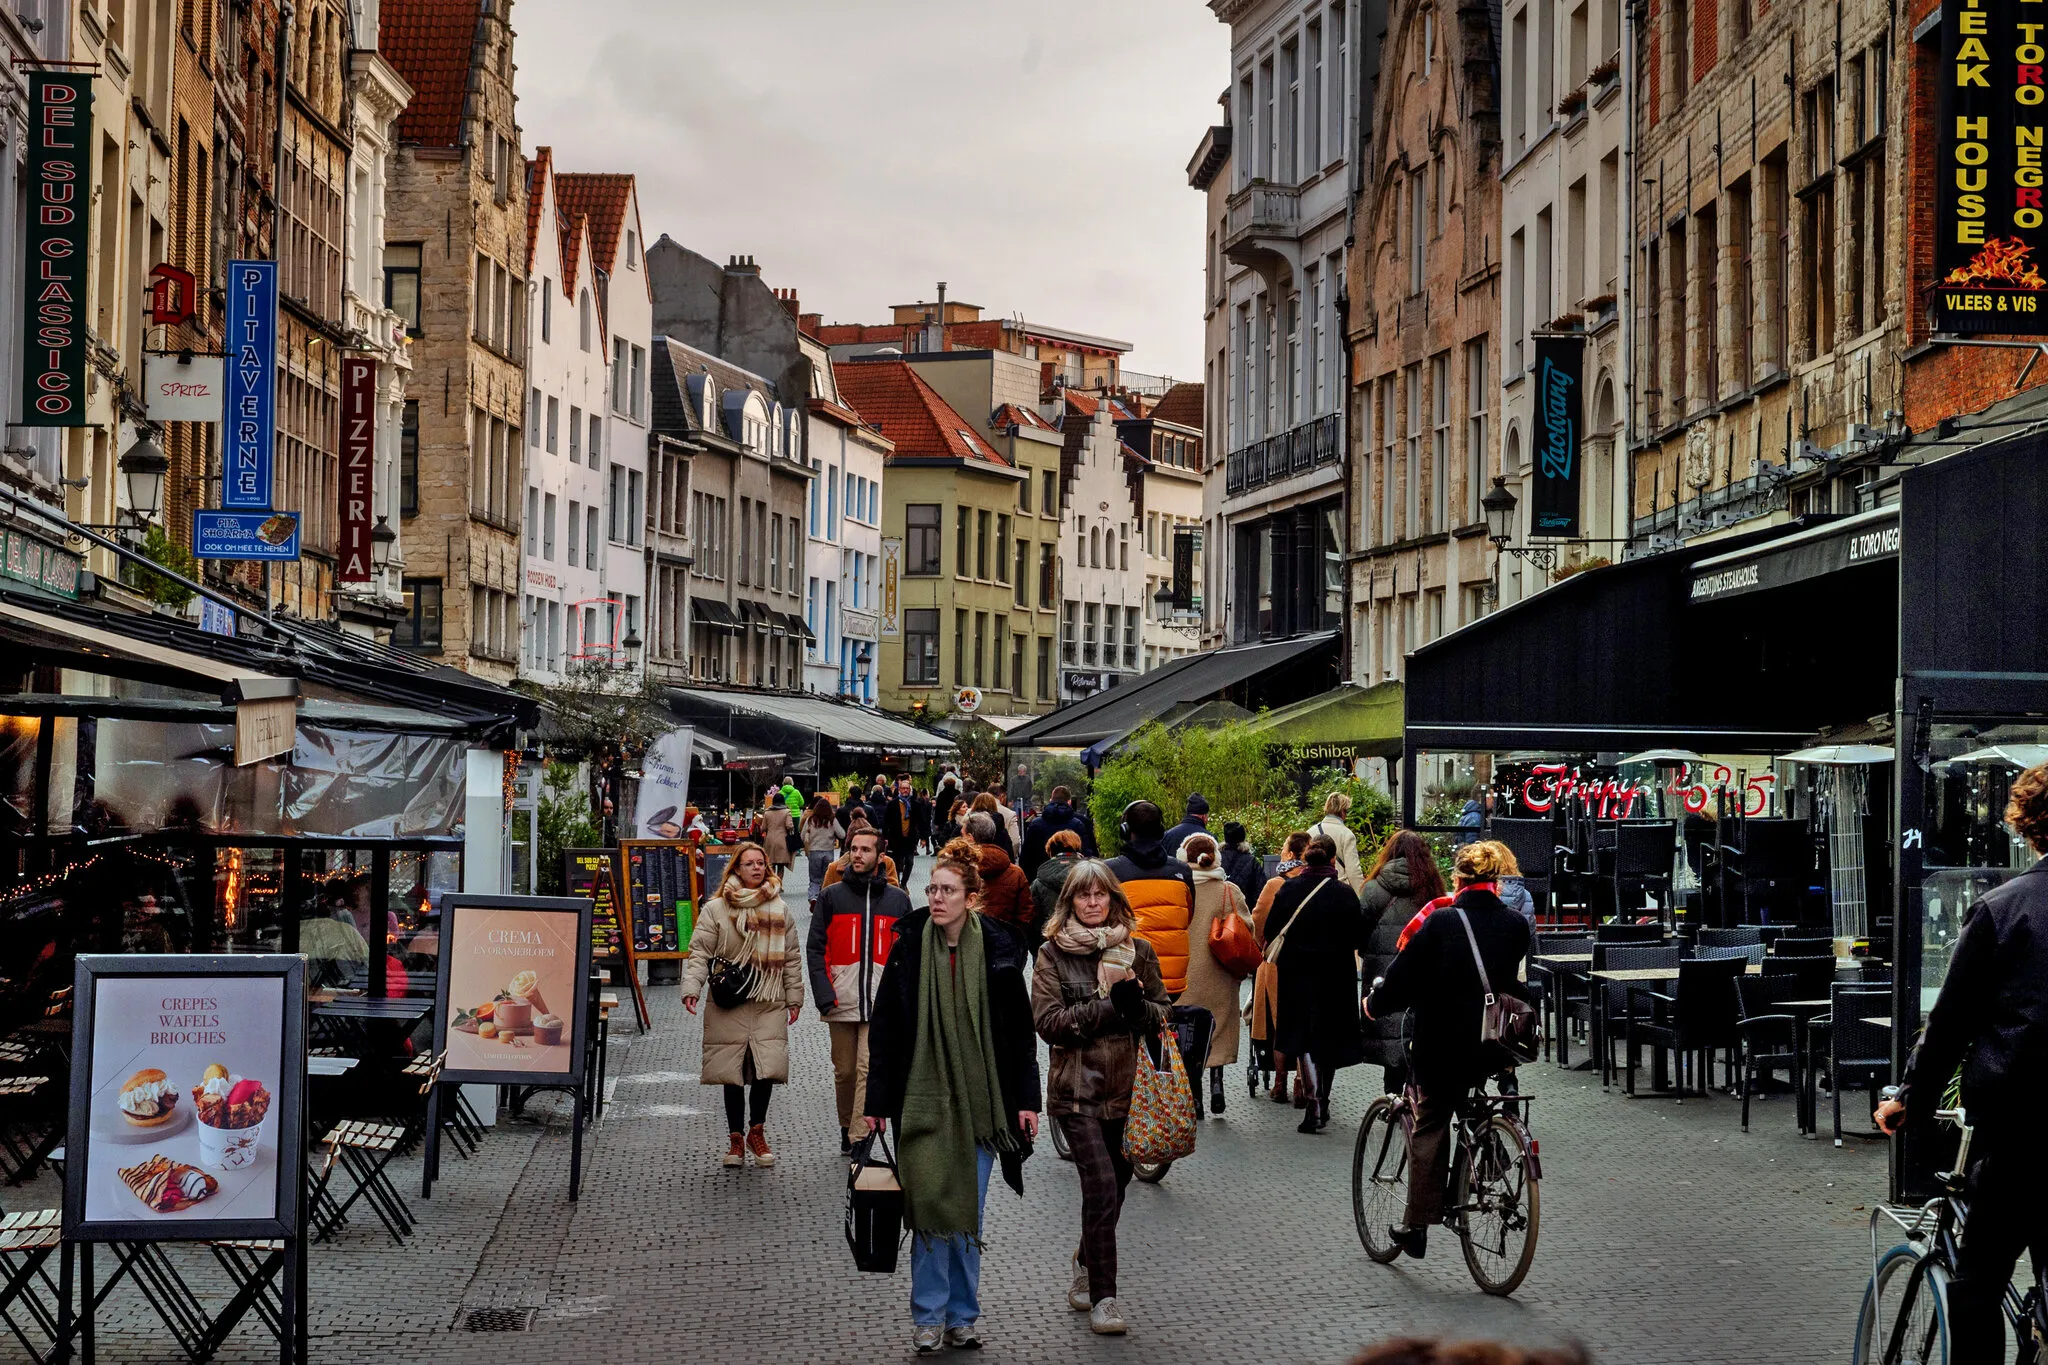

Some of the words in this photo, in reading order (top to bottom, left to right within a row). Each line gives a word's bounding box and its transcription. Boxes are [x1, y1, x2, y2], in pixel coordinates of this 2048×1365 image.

[1956, 0, 1991, 87] EAK
[2015, 23, 2045, 105] TORO
[42, 84, 77, 148] DEL
[1955, 116, 1989, 244] HOUSE
[2013, 126, 2044, 229] NEGRO
[40, 160, 76, 225] SUD
[1945, 294, 1993, 311] VLEES
[1997, 295, 2008, 312] &
[2012, 295, 2037, 312] VIS
[36, 237, 74, 415] CLASSICO
[160, 382, 210, 397] SPRITZ
[237, 269, 262, 494] PITAVERNE
[1541, 356, 1574, 481] Zaowang
[345, 366, 369, 575] PIZZERIA
[202, 528, 255, 539] SHOARMA
[217, 517, 240, 528] PITA
[7, 534, 23, 574] DEL
[25, 541, 41, 580] SUD
[204, 543, 223, 551] OOK
[238, 544, 253, 552] MEE
[1850, 537, 1858, 559] EL
[1859, 531, 1881, 558] TORO
[1178, 543, 1189, 600] VERONA
[1722, 564, 1759, 592] STEAKHOUSE
[1292, 744, 1357, 759] sushibar
[474, 945, 486, 954] EN
[487, 946, 555, 957] ORANJEBLOEM
[488, 929, 543, 945] CREMA
[161, 997, 218, 1011] CREPES
[159, 1014, 220, 1027] WAFELS
[150, 1031, 226, 1045] BRIOCHES
